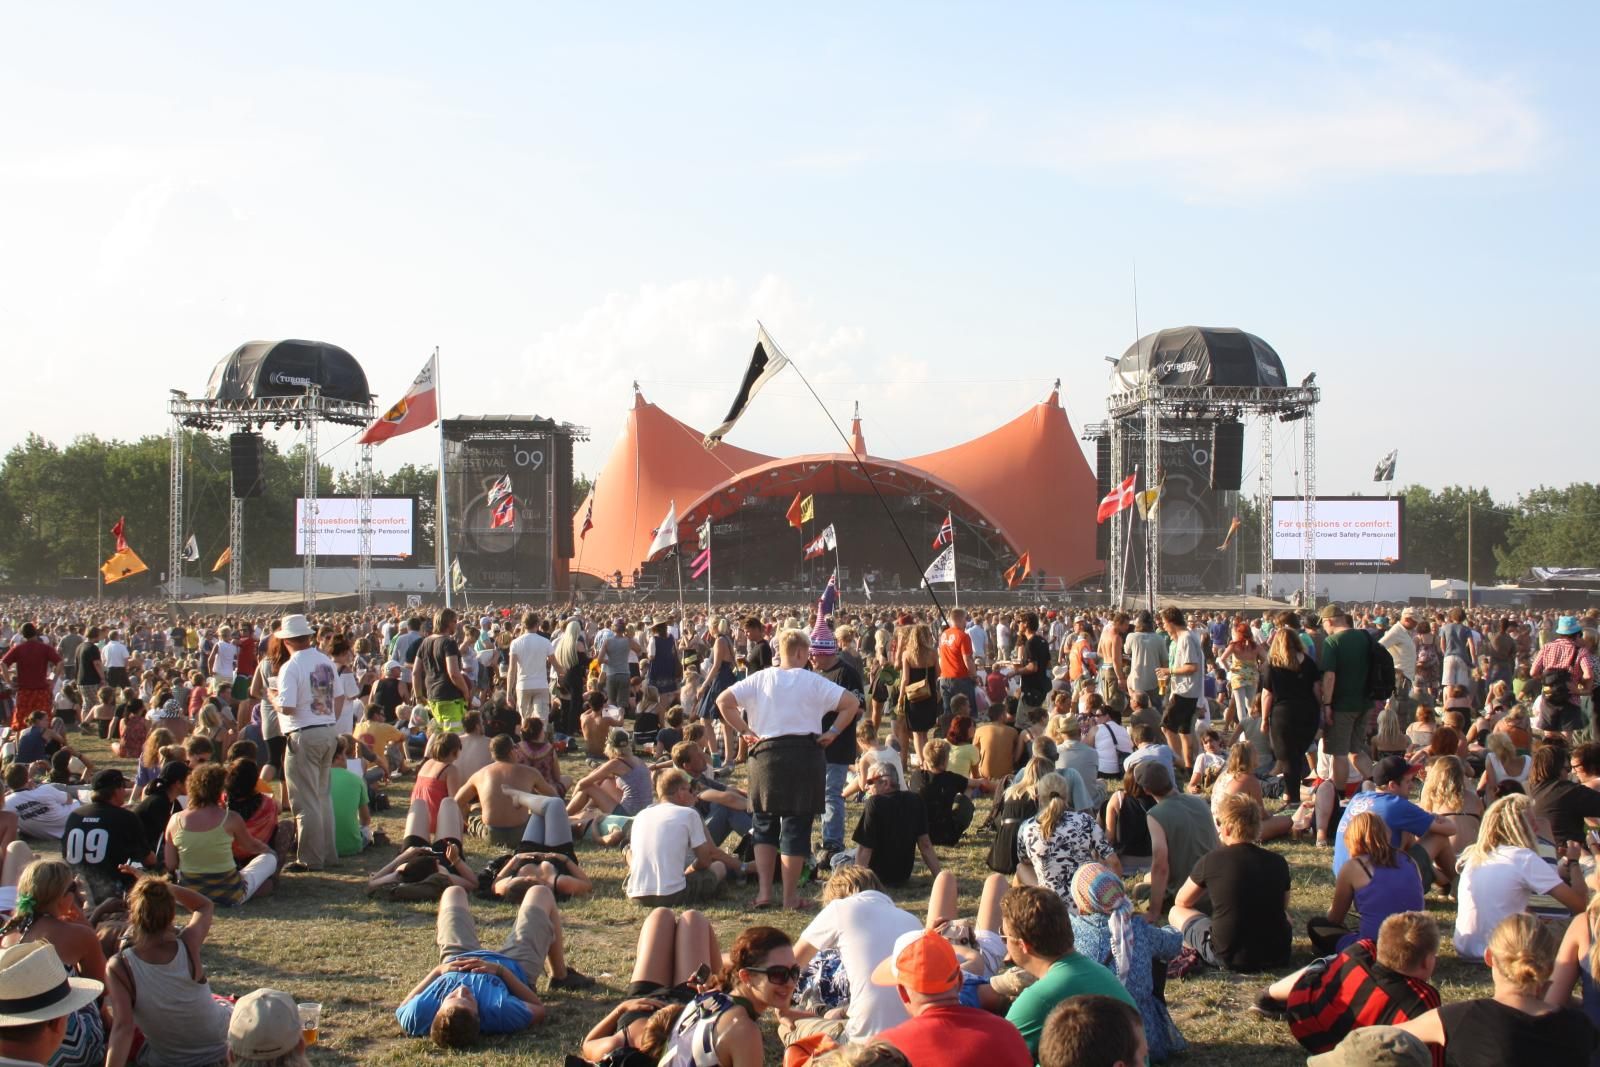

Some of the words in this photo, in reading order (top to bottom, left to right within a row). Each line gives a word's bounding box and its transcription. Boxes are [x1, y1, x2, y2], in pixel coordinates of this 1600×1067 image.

[513, 444, 543, 471] '09
[318, 517, 359, 526] questions
[372, 517, 407, 525] comfort:
[1278, 520, 1292, 528] For
[1295, 520, 1340, 529] questions
[1355, 519, 1393, 528] comfort:
[1339, 531, 1360, 539] Safety
[66, 828, 109, 865] 09
